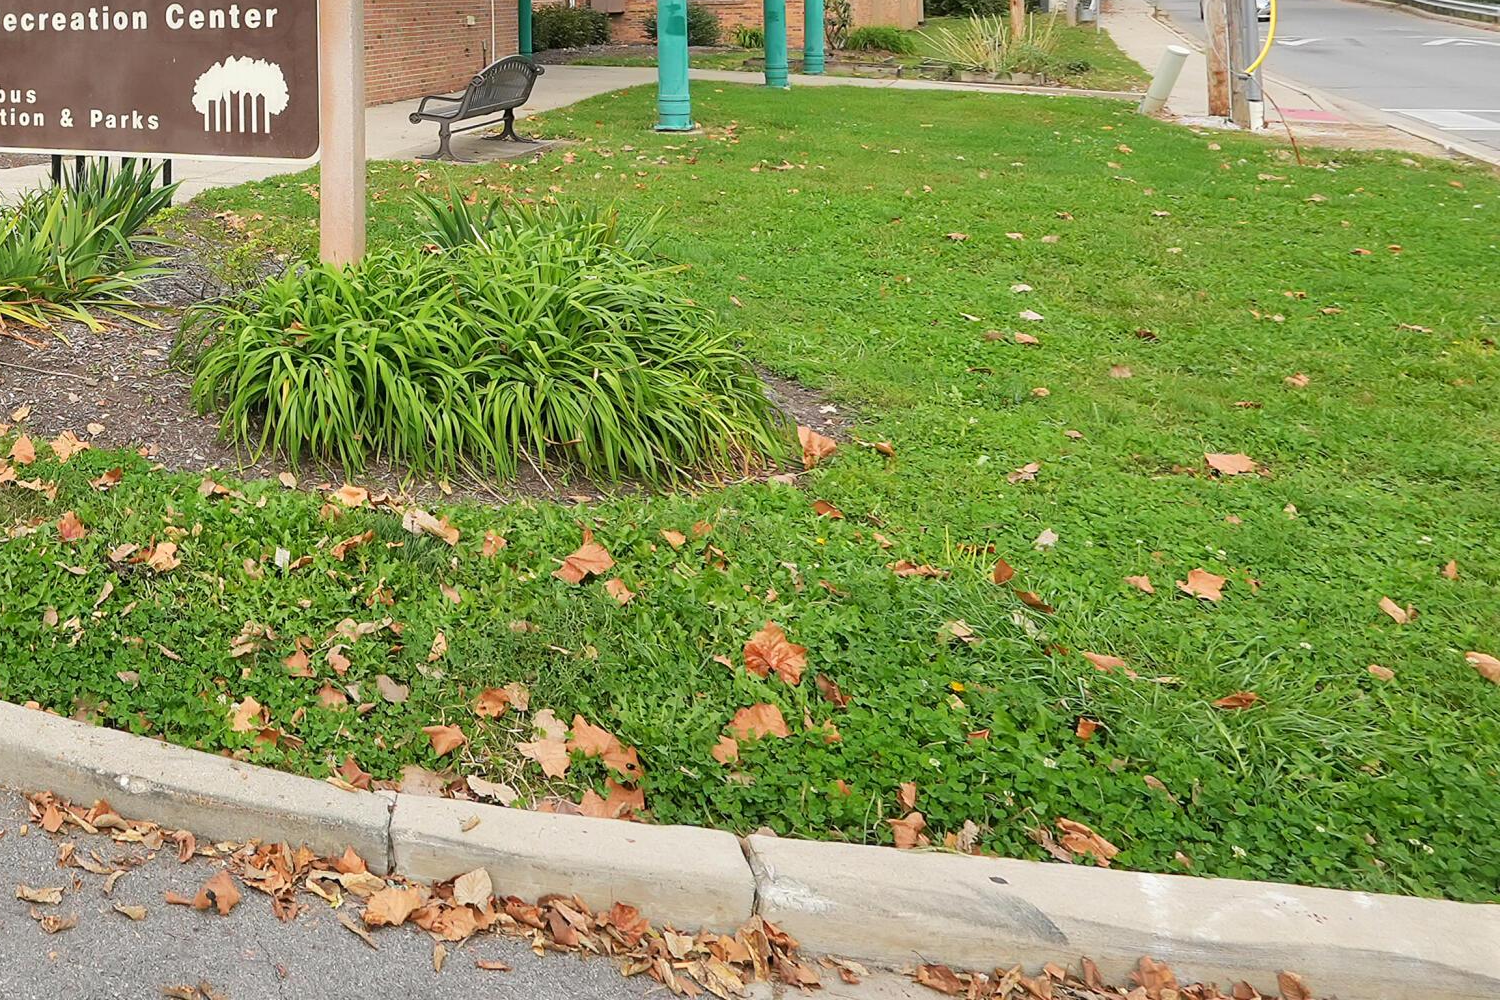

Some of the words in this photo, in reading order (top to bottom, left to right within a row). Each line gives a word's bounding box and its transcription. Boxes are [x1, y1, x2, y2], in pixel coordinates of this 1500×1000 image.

[165, 3, 278, 30] Center
[59, 108, 74, 128] &
[90, 109, 159, 130] Parks
